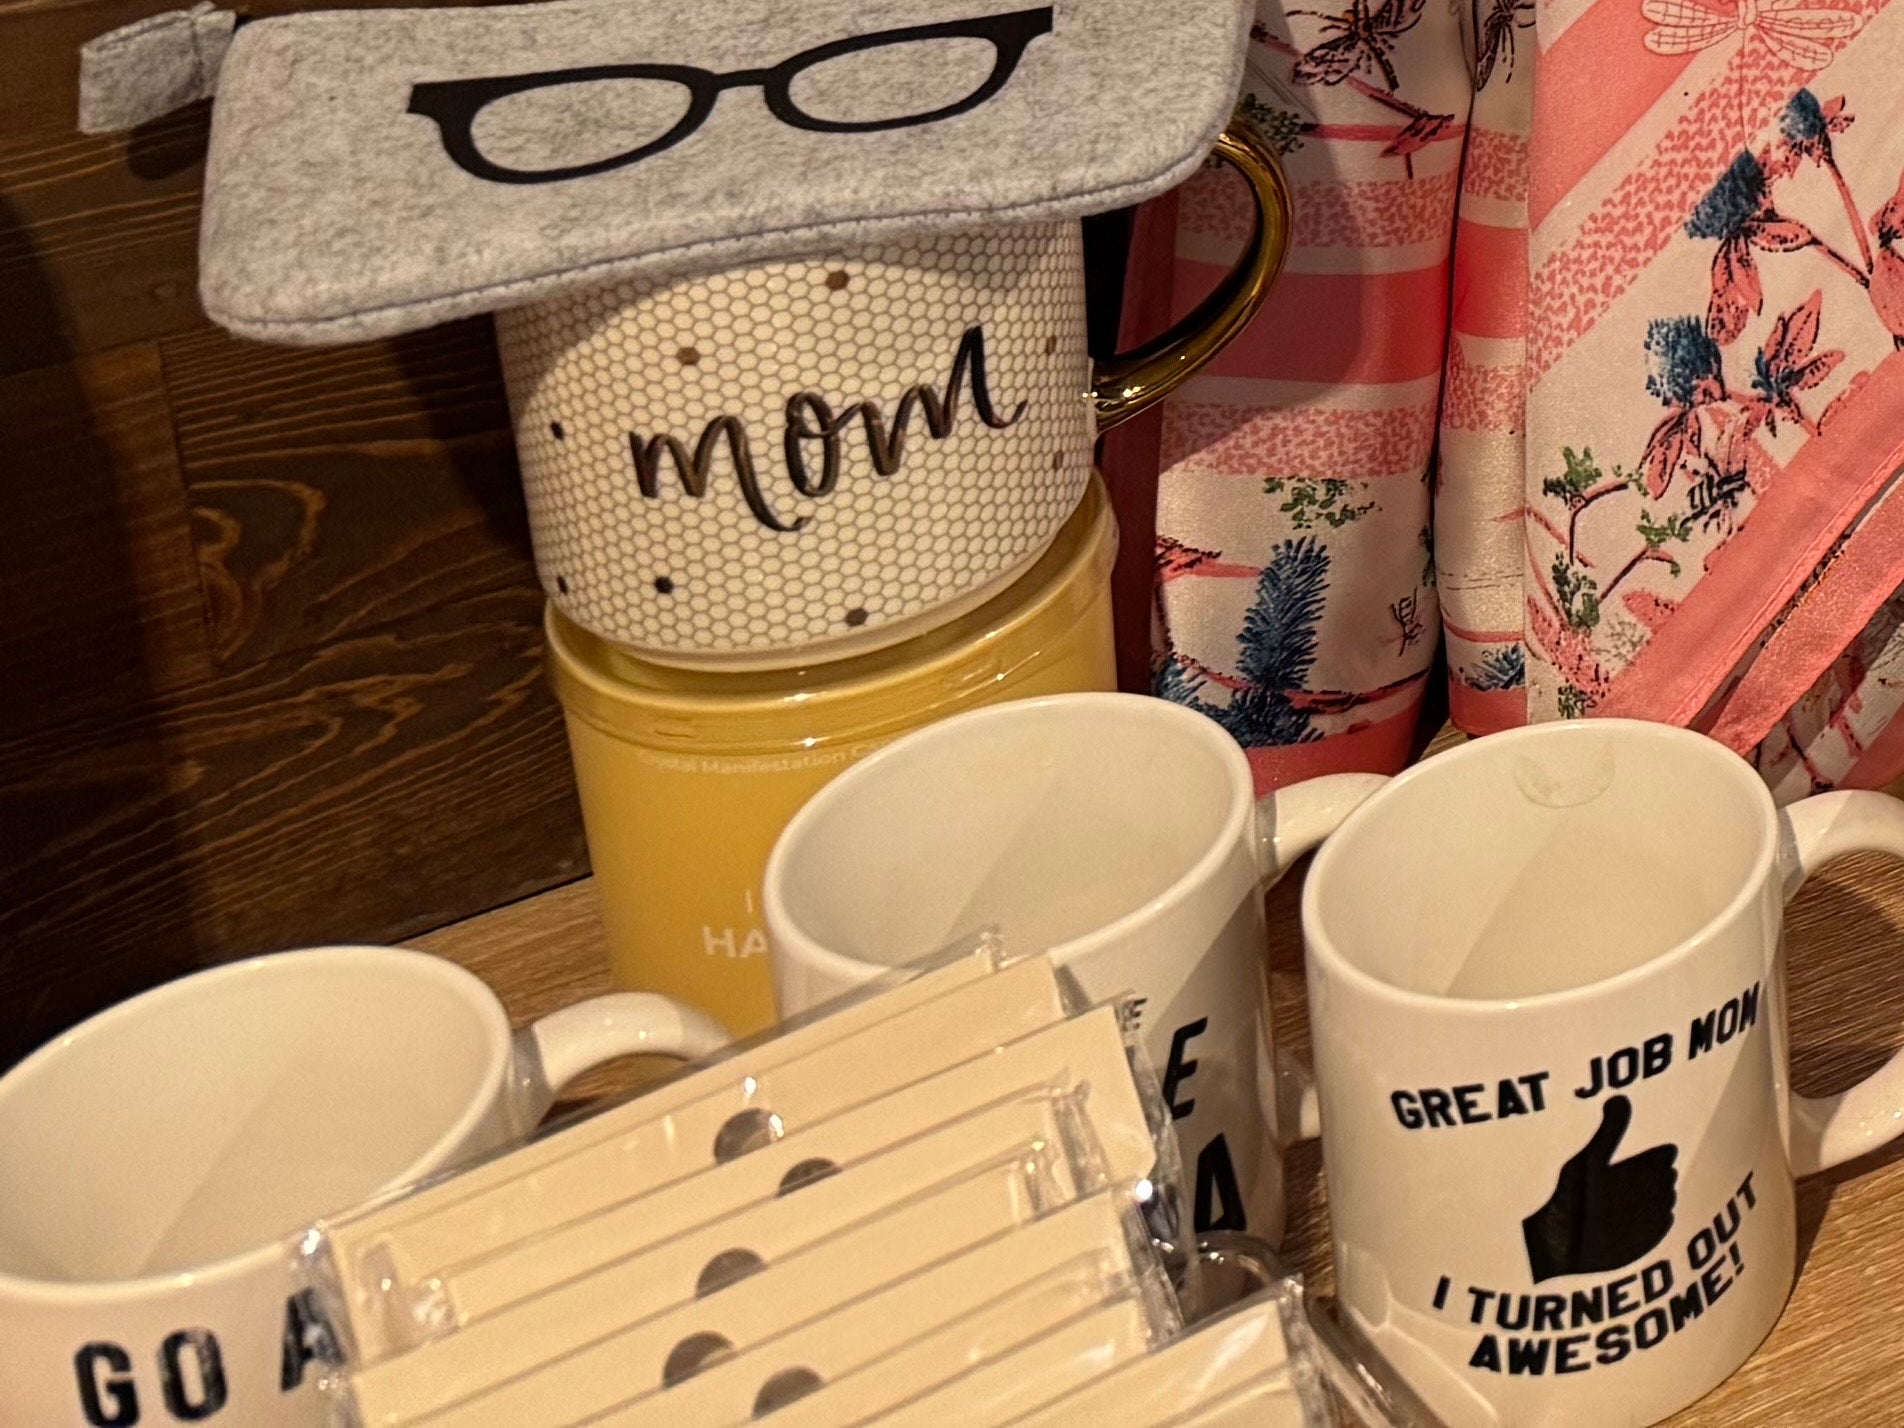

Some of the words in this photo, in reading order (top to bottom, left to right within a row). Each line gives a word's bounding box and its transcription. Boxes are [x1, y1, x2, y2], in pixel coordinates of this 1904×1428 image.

[629, 325, 1029, 532] mom
[1391, 1070, 1550, 1130] GREAT
[1574, 1031, 1674, 1100] JOB
[1688, 980, 1760, 1061] MOM
[1432, 1274, 1451, 1311] I
[1467, 1258, 1675, 1333] TURNED
[1686, 1169, 1758, 1272] OUT
[1468, 1240, 1746, 1377] AWESOME!
[74, 1325, 229, 1428] GO
